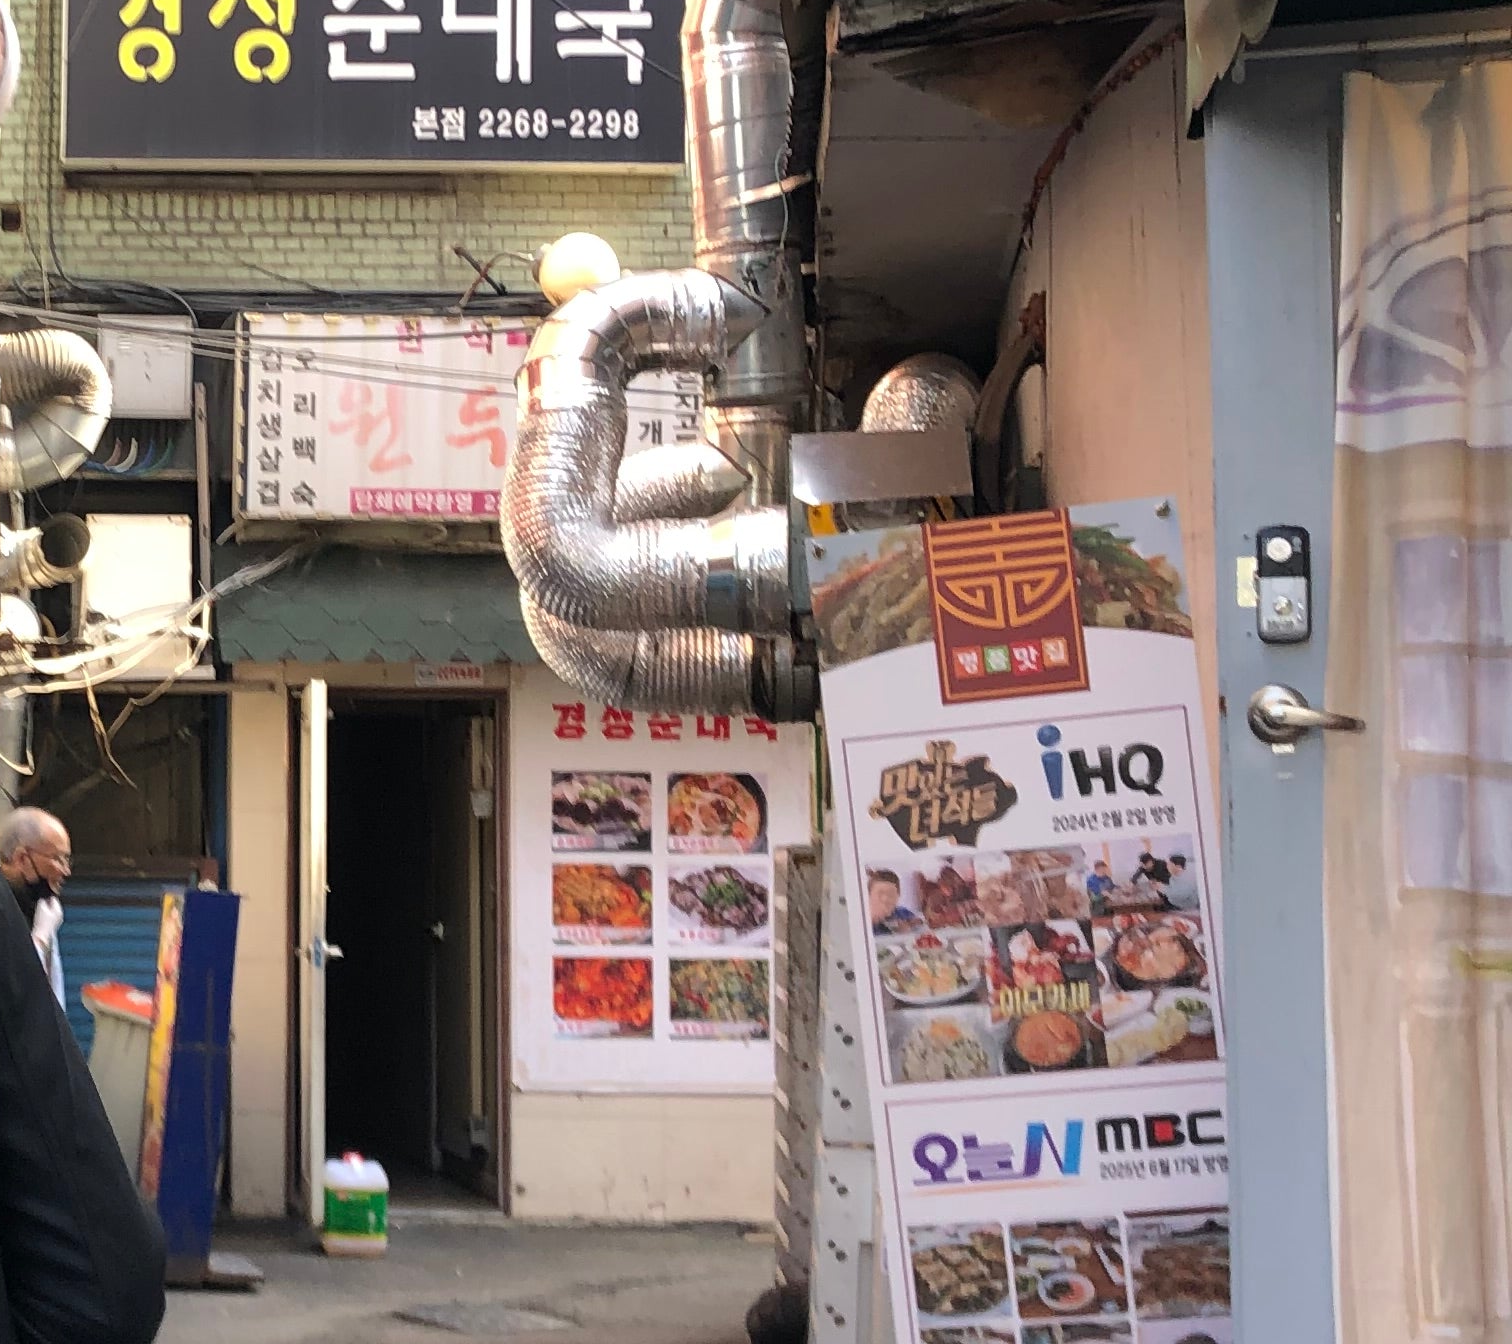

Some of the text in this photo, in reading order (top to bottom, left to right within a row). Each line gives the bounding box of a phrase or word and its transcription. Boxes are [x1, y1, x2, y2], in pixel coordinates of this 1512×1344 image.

[412, 107, 641, 142] 본점 2268-2298
[912, 1119, 1085, 1187] 오늘N
[1095, 1109, 1226, 1154] MBC
